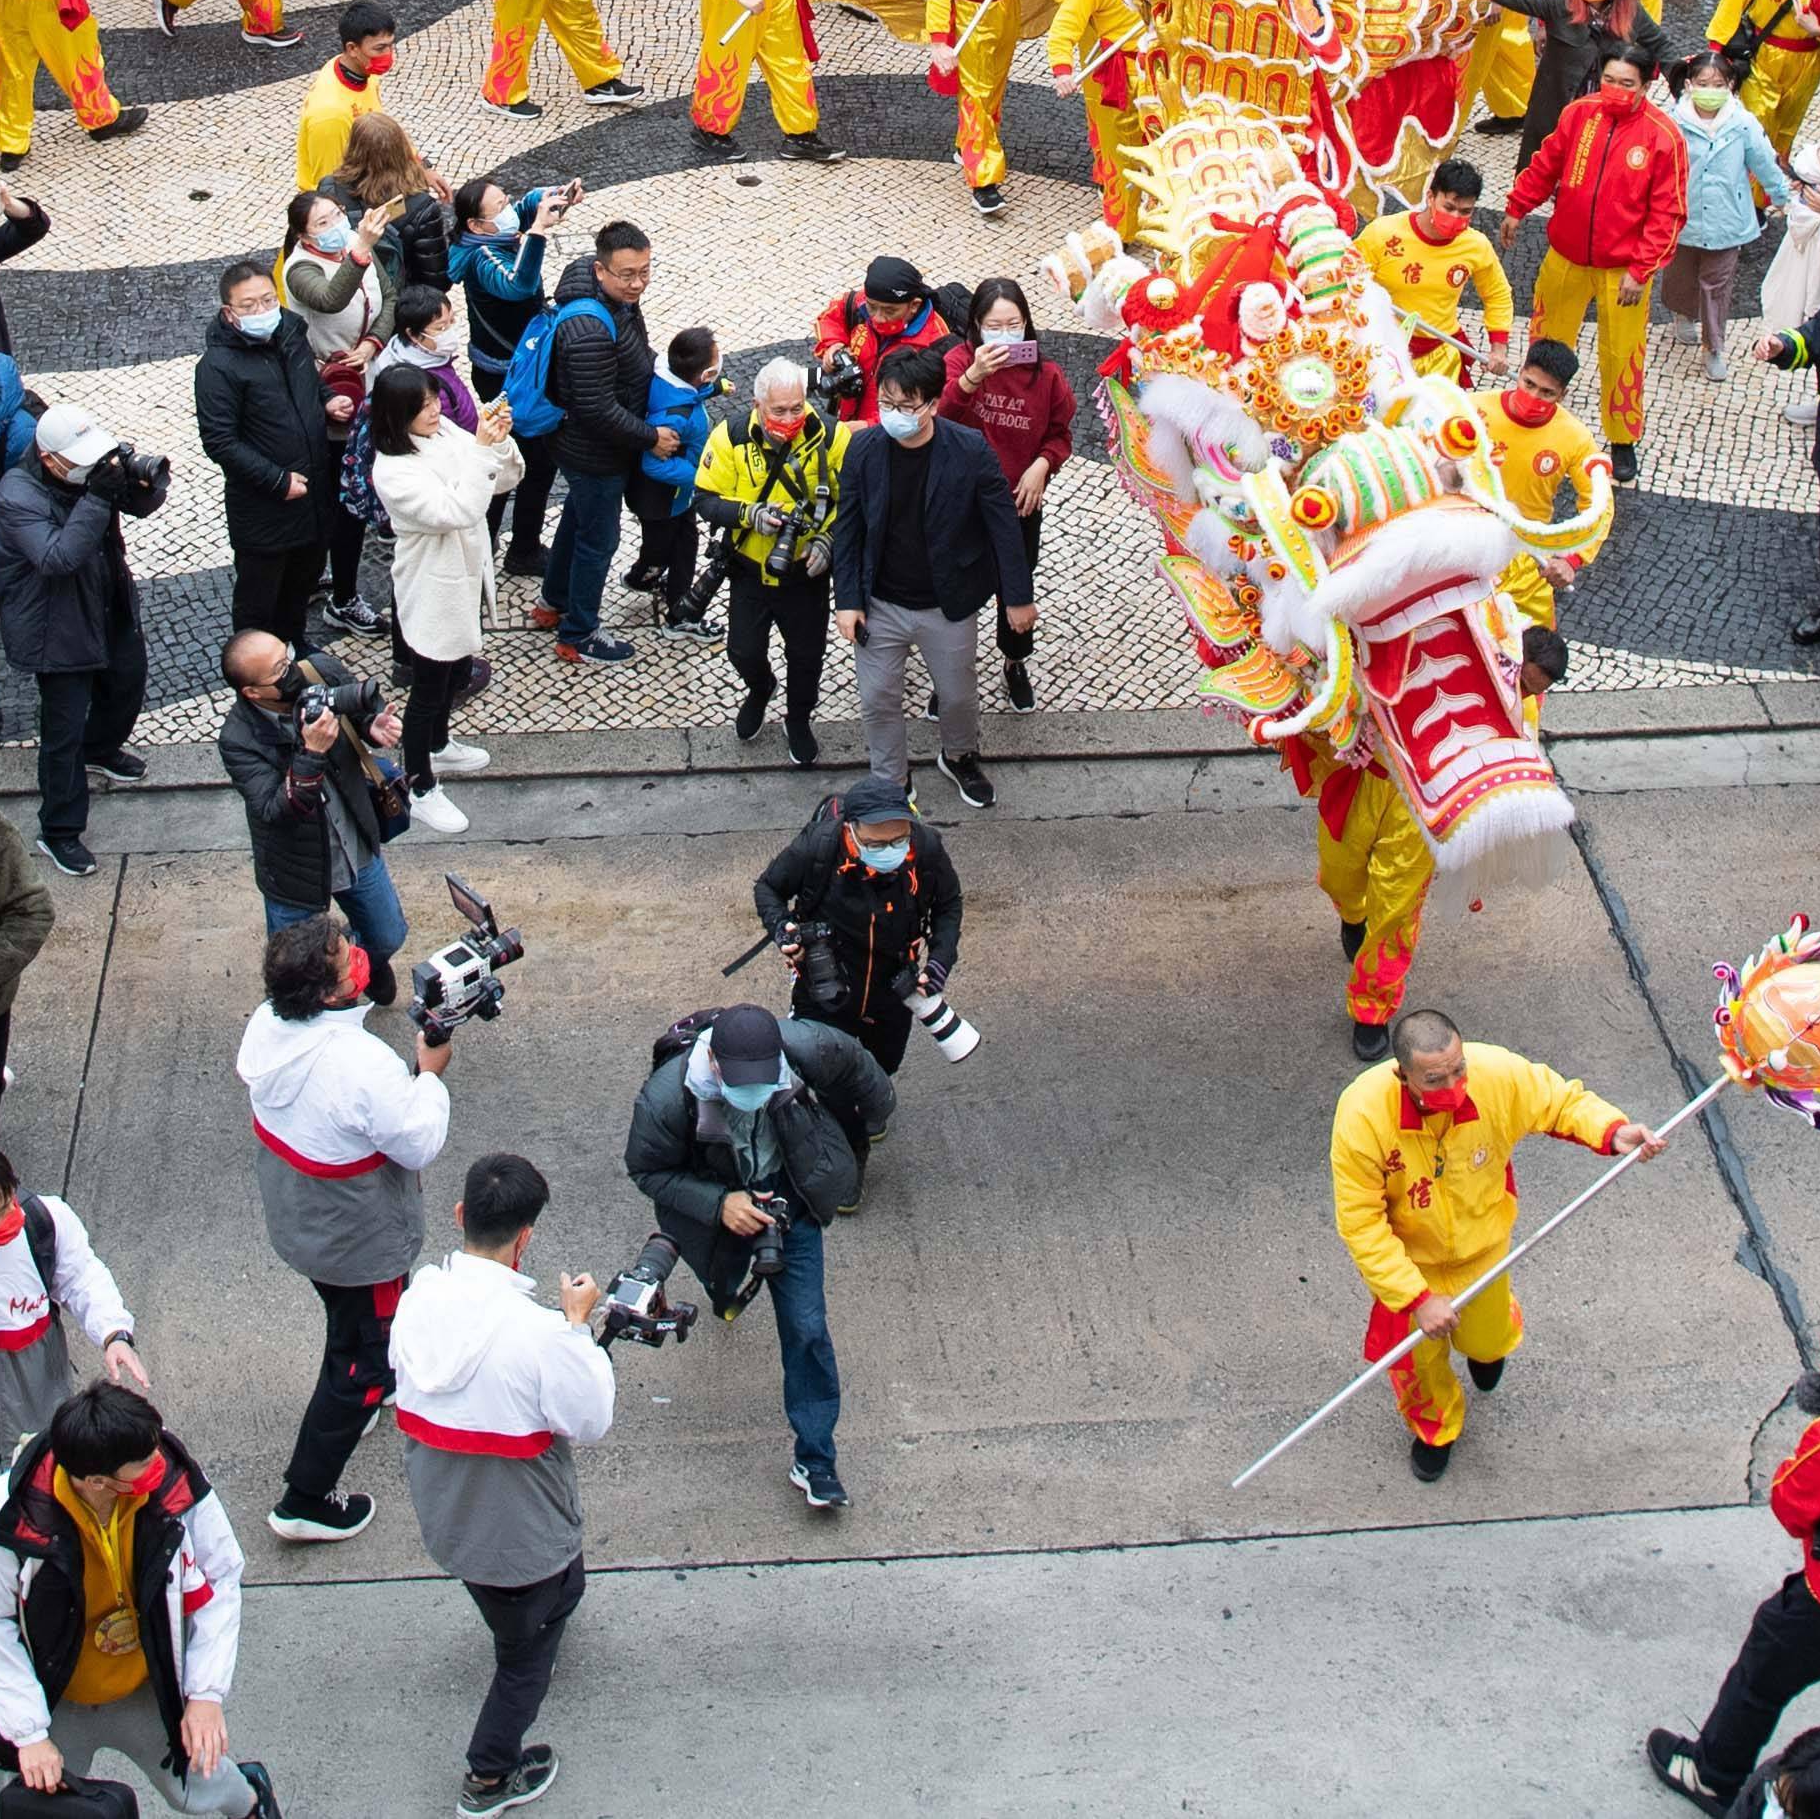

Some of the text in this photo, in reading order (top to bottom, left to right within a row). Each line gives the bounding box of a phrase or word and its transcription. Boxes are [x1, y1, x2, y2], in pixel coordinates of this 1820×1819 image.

[1384, 235, 1425, 285] 忠信
[984, 393, 1026, 411] TAY AT
[997, 412, 1032, 431] ROCK
